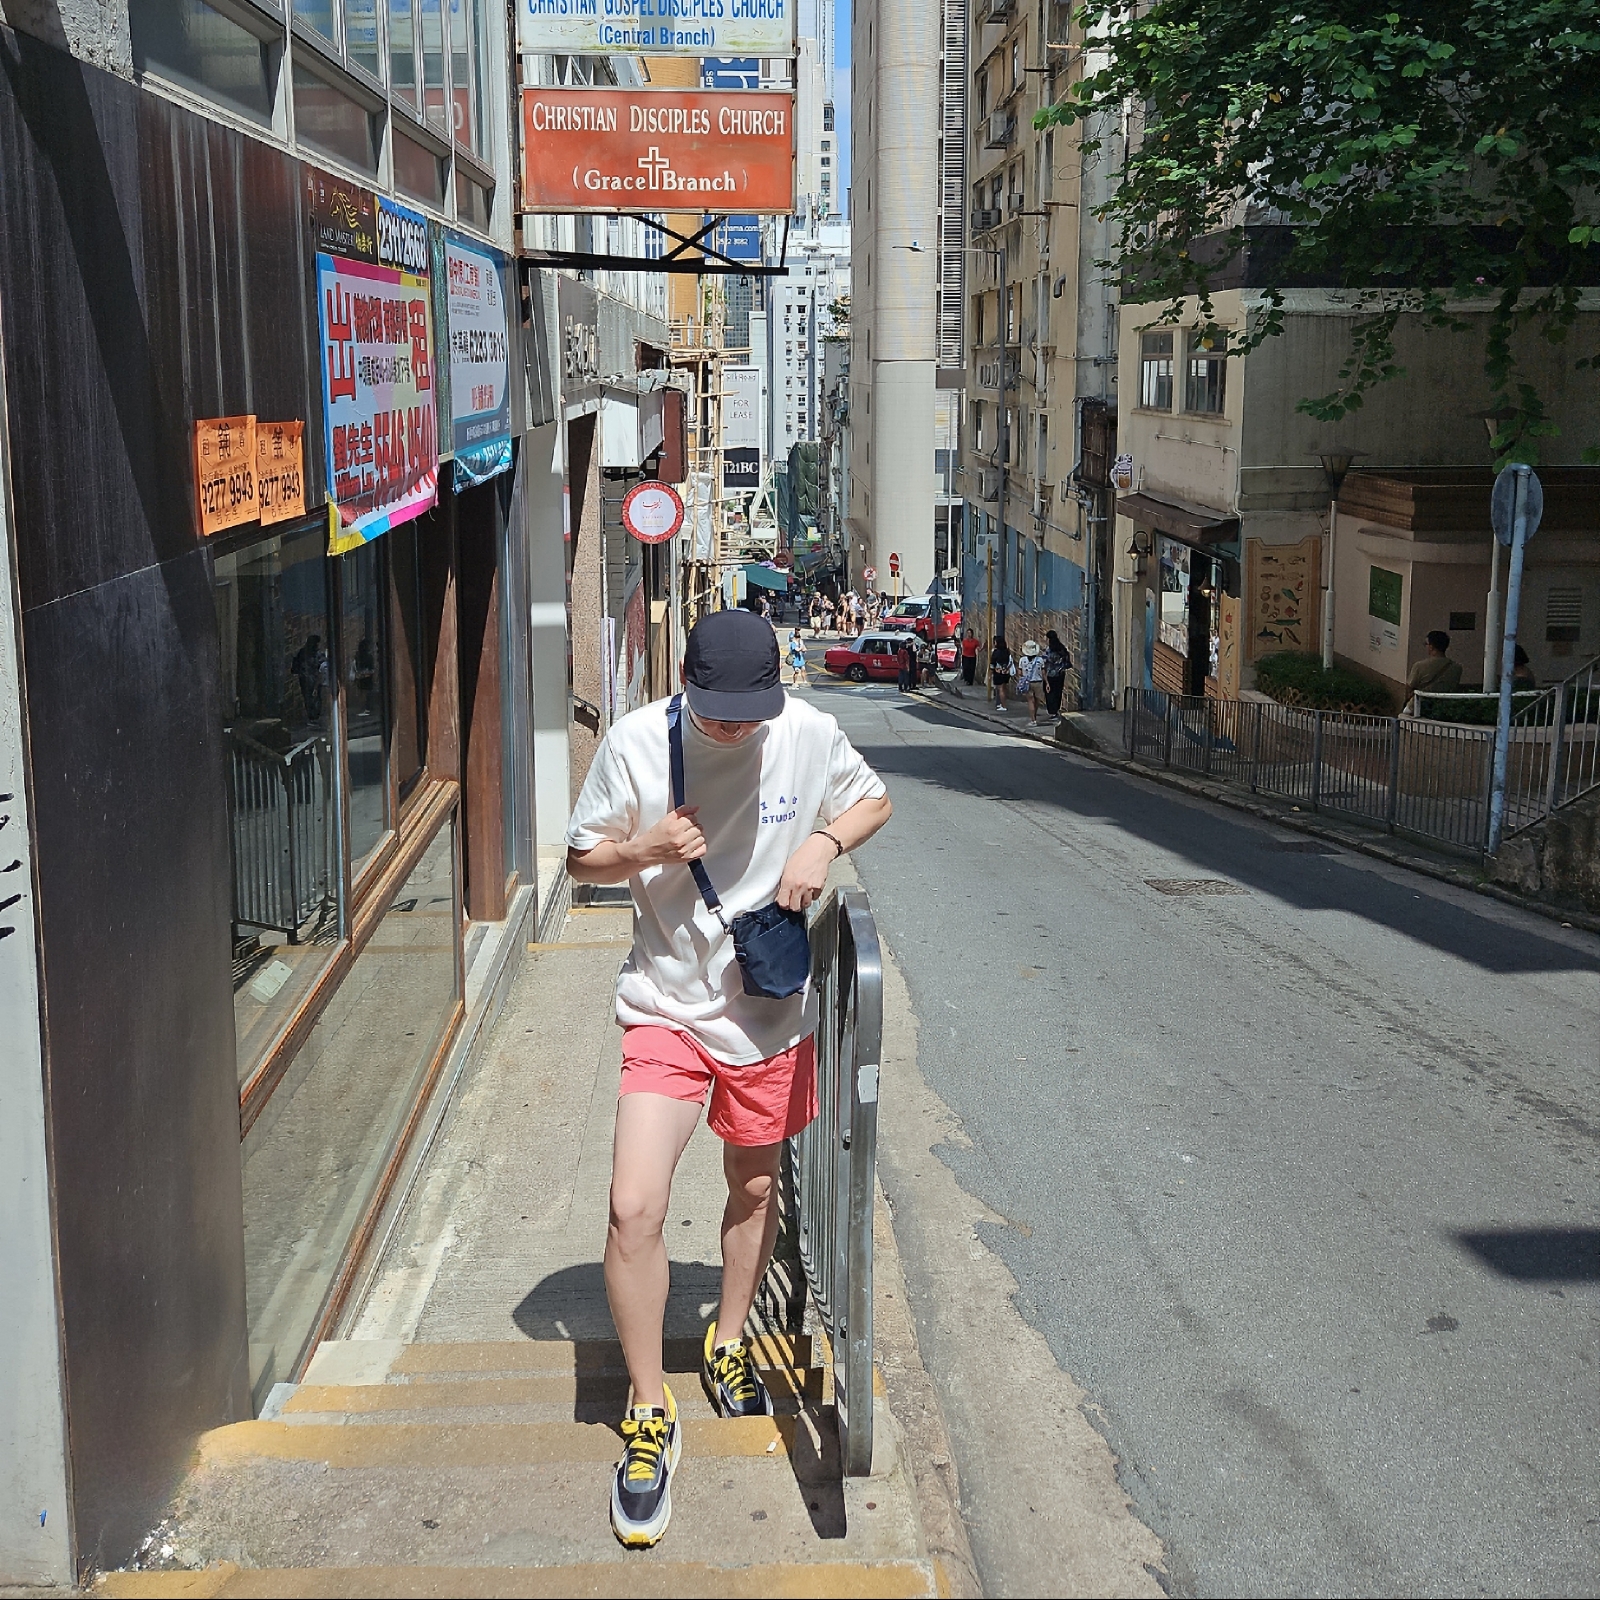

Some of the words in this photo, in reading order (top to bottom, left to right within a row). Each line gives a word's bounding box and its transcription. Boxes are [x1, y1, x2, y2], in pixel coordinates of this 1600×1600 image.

[598, 23, 655, 45] (Central
[660, 26, 715, 48] Branch)
[532, 102, 617, 131] CHRISTIAN
[629, 104, 710, 134] DISCIPLES
[718, 106, 785, 136] CHURCH
[730, 411, 753, 419] LEASE
[733, 399, 750, 408] FOR
[229, 470, 254, 507] 9943
[258, 475, 279, 509] 9277
